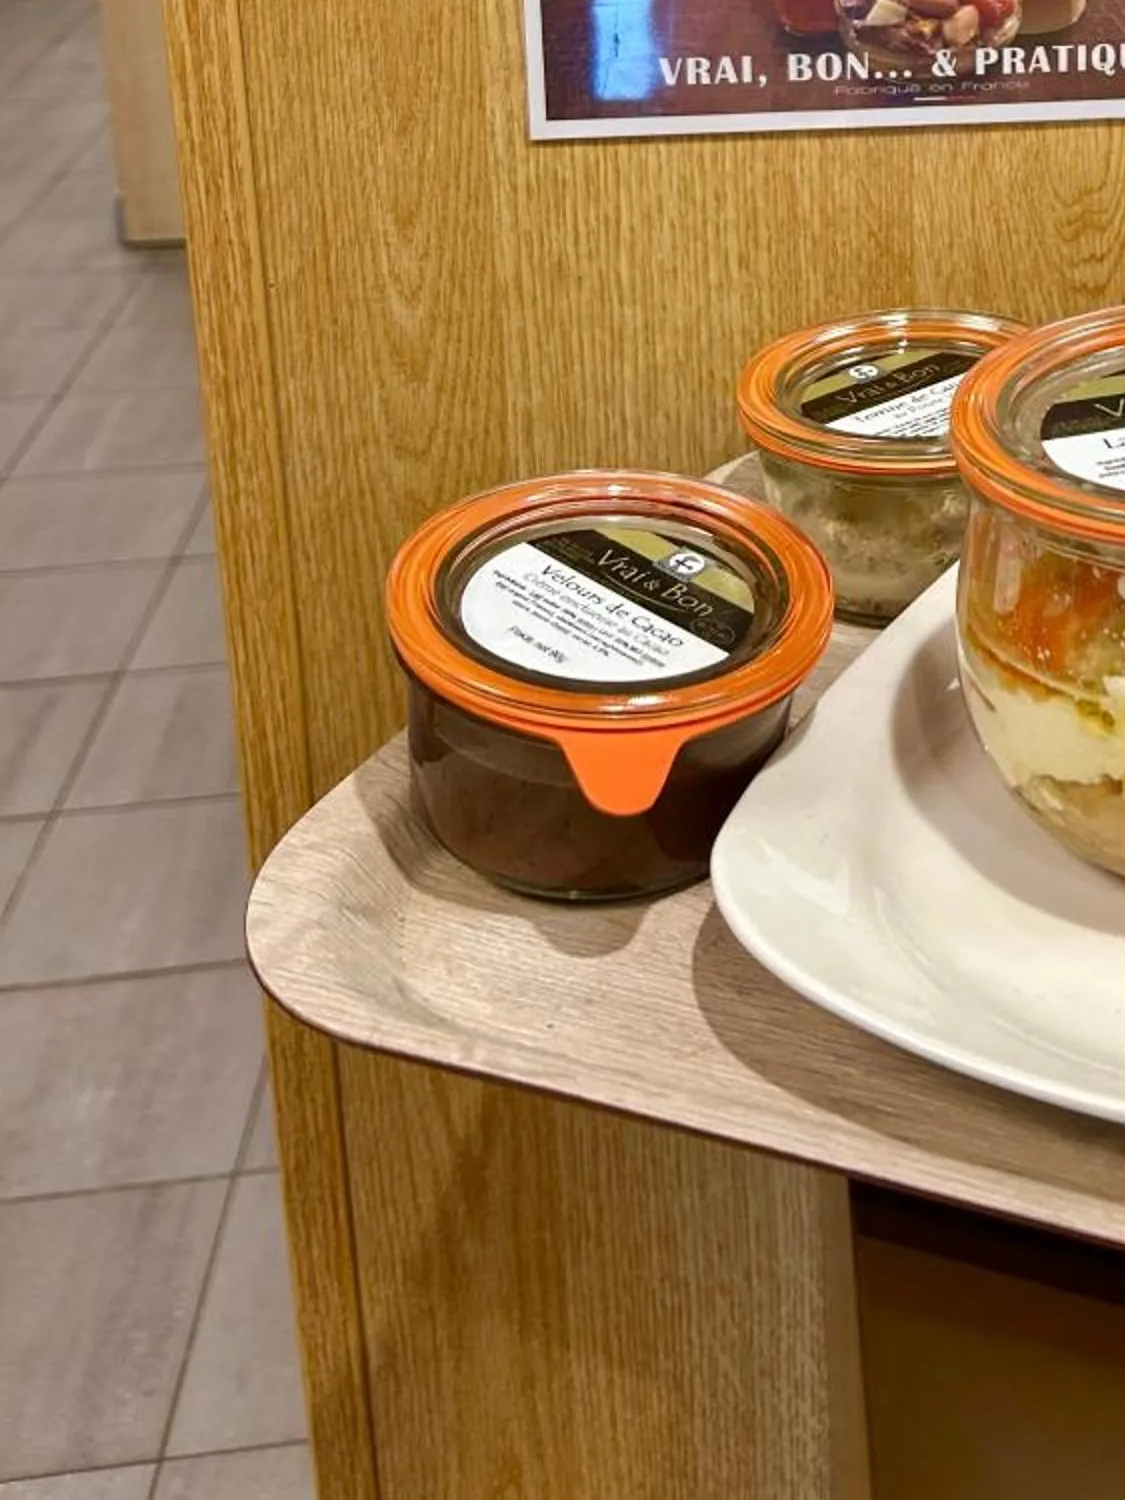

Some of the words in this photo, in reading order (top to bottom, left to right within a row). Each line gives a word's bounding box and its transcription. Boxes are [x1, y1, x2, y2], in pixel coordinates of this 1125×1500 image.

[659, 56, 767, 88] VRAI,
[788, 51, 912, 81] BON...
[932, 49, 957, 77] &
[929, 83, 954, 93] en
[541, 565, 601, 605] Velours
[606, 603, 629, 618] de
[632, 616, 684, 647] Cacao
[598, 549, 645, 583] Vrai
[644, 579, 660, 591] &
[661, 583, 713, 617] Bon
